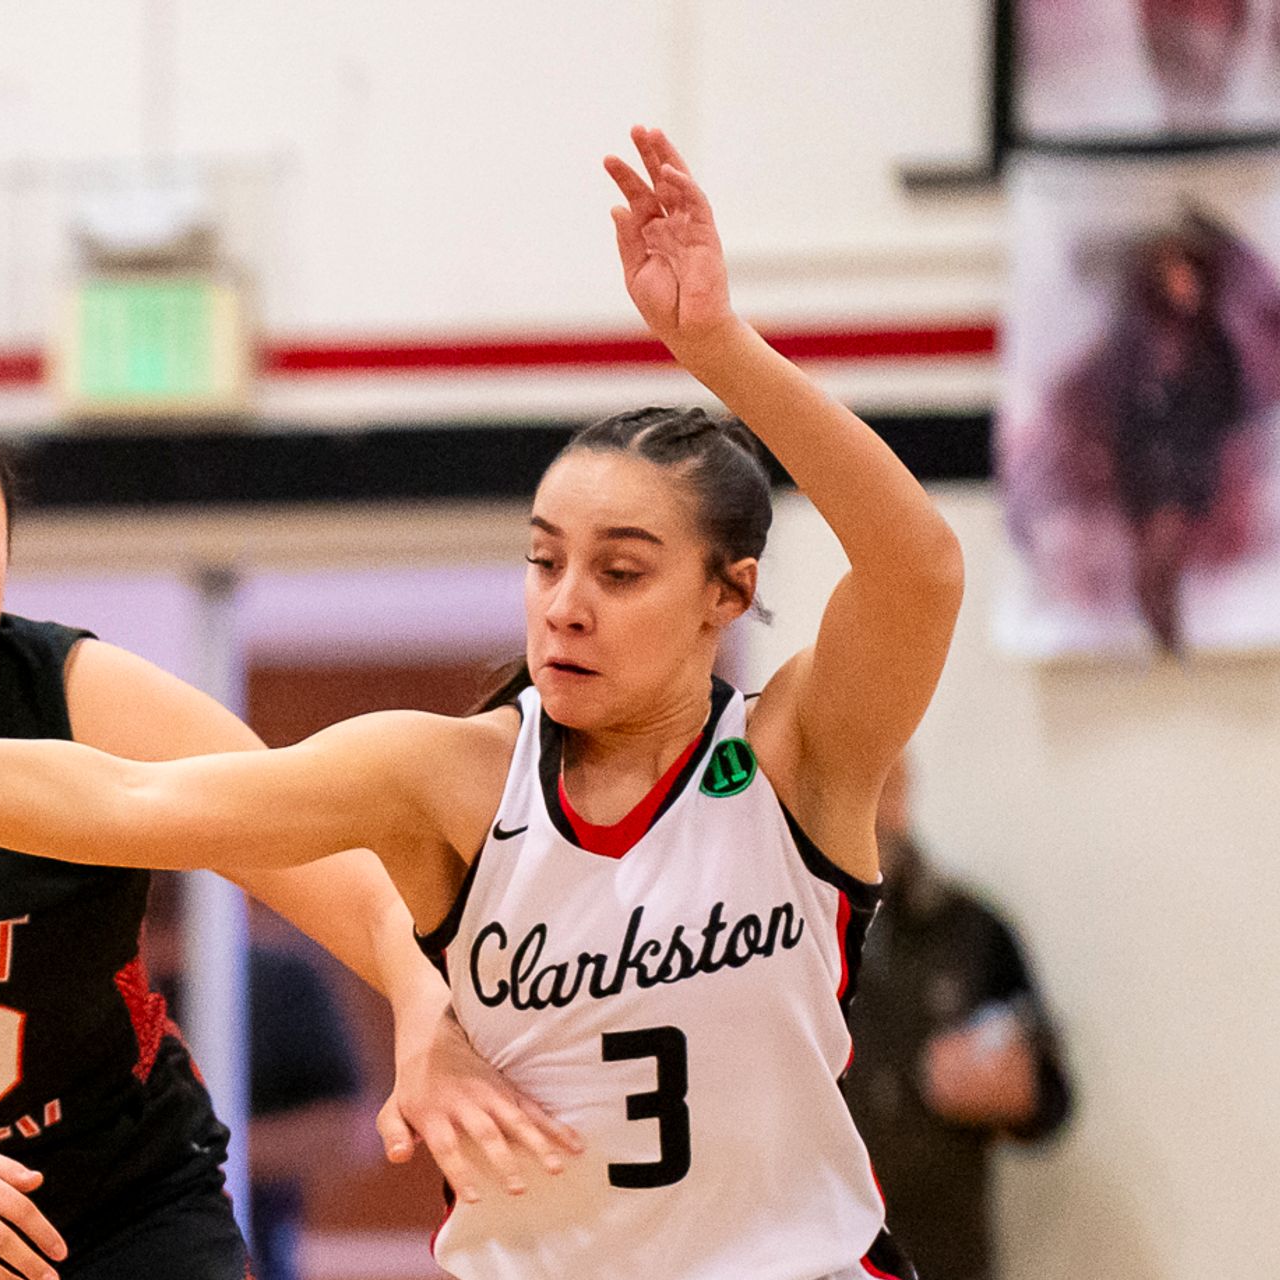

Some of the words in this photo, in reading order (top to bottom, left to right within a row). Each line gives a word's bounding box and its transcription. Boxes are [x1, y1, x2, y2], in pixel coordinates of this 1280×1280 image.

[709, 742, 747, 790] 11
[470, 902, 804, 1011] Clarkston
[602, 1026, 691, 1189] 3
